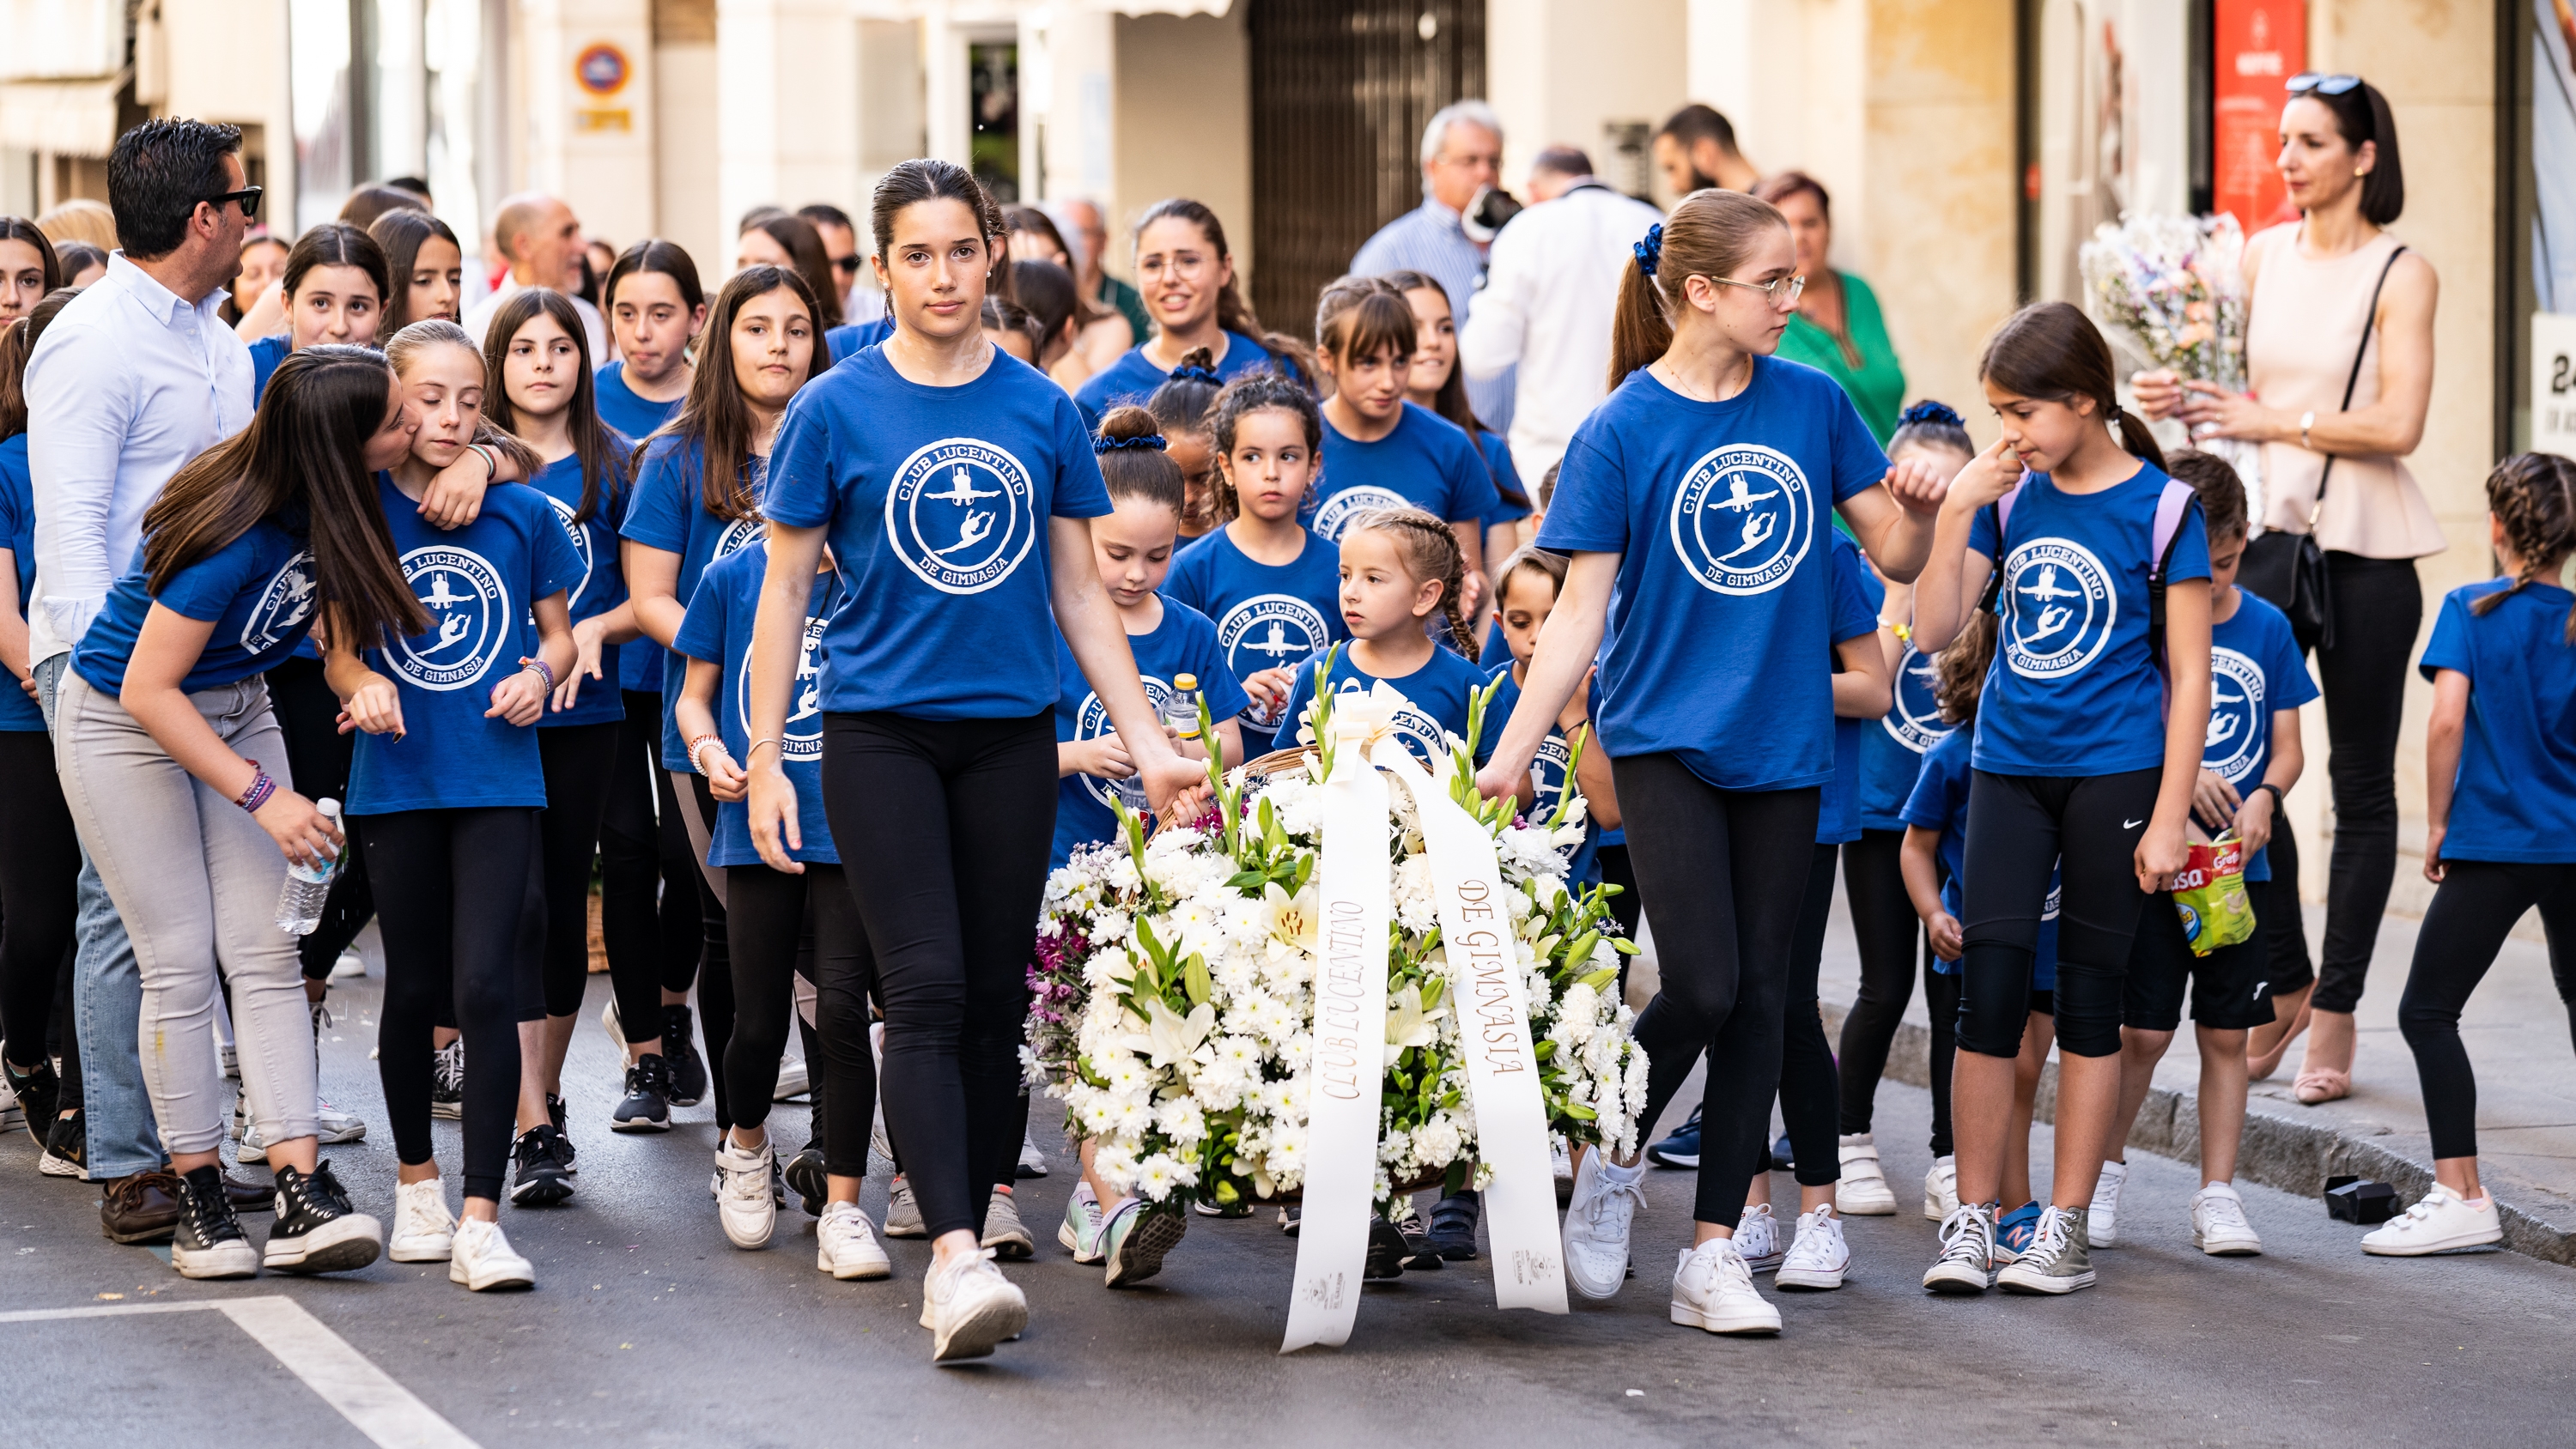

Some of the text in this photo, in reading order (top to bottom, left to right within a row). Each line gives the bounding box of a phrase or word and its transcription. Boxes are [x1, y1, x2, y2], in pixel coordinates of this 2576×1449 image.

[899, 446, 1025, 501] CLUB LUCENTINO
[1683, 452, 1801, 514] CLUB LUCENTINO
[415, 554, 498, 600] LUCENTINO
[918, 556, 1009, 585] DE GIMNASIA
[1705, 554, 1794, 587] DE GIMNASIA
[2006, 545, 2105, 600] CLUB LUCENTINO
[1221, 602, 1325, 651] CLUB LUCENTINO
[402, 656, 484, 682] DE GIMNASIA
[2007, 642, 2085, 670] DE GIMNASIA
[1084, 700, 1105, 731] CLU
[1898, 723, 1919, 741] DE
[1319, 900, 1365, 1100] CLUB LUCENTINO
[1455, 879, 1525, 1077] DE GIMNASIA
